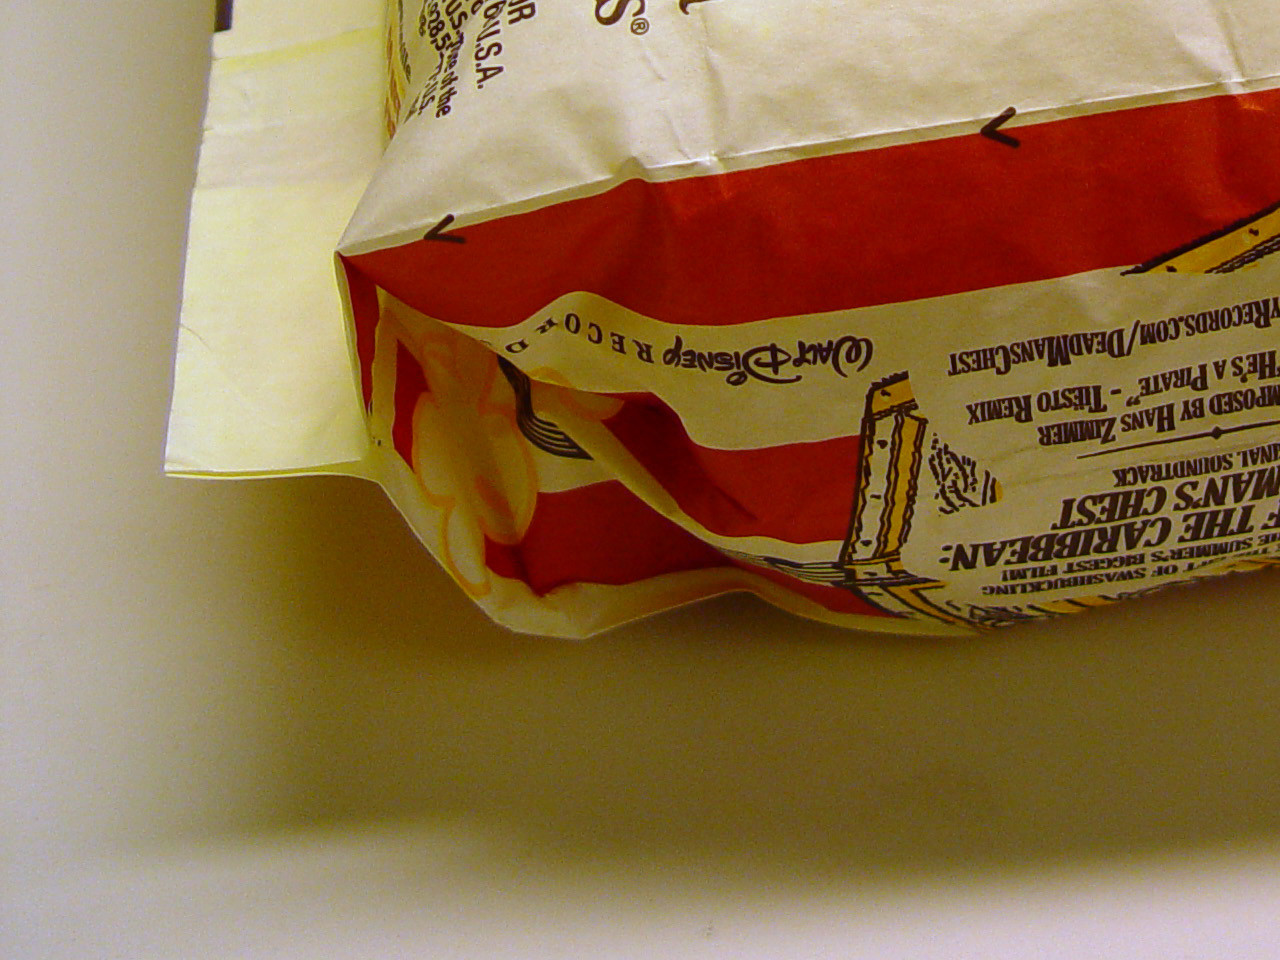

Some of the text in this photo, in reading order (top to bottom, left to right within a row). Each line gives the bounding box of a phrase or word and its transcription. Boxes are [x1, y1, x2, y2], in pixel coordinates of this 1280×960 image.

[474, 20, 504, 90] U.S.A.
[1181, 399, 1206, 421] BY
[1113, 451, 1234, 488] SOUNDTRACK
[1051, 485, 1168, 531] CHEST
[1185, 504, 1256, 542] THE
[938, 517, 1179, 572] CARIBBEAN:
[1000, 565, 1057, 581] FILM!
[1061, 554, 1145, 574] BIGGEST
[1150, 565, 1179, 577] OF
[981, 567, 1146, 596] SWASHBUCKLING
